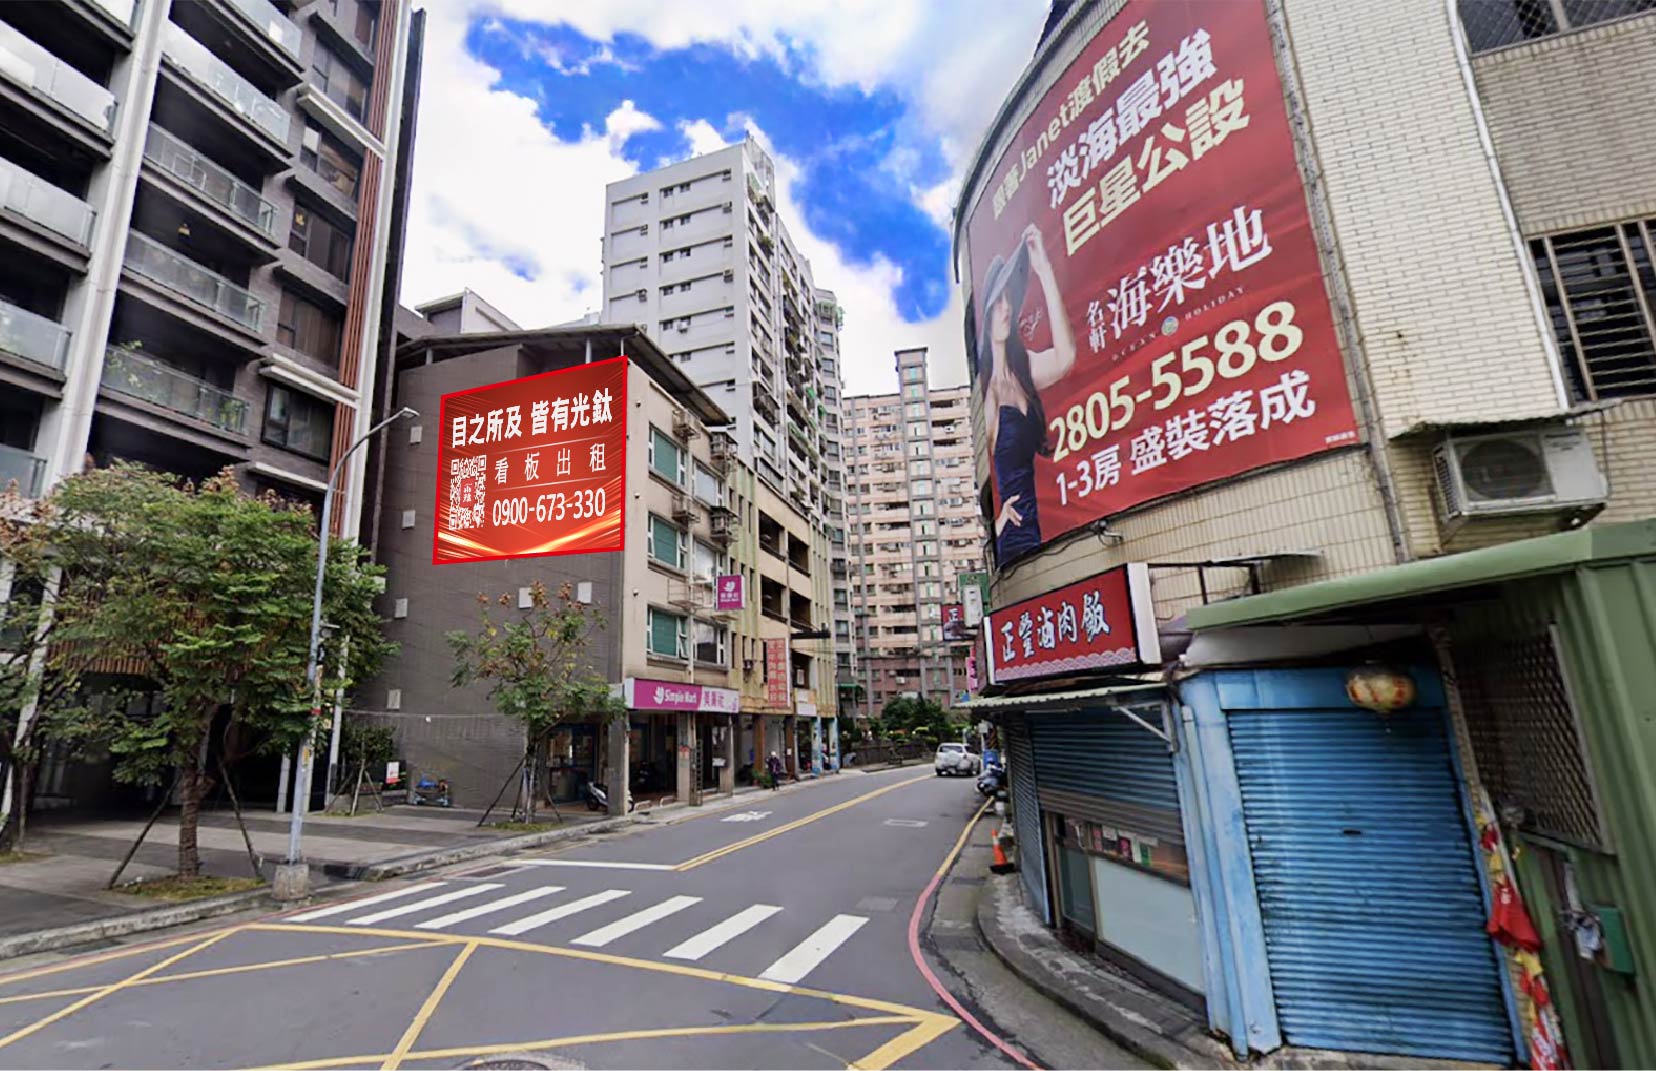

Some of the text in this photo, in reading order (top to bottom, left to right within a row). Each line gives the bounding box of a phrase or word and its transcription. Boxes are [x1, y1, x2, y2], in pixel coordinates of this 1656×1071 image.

[1045, 28, 1218, 209] 淡海最強
[1062, 79, 1250, 256] 巨星公設
[1107, 205, 1272, 340] 海樂地
[1184, 286, 1245, 321] HOLIDAY
[452, 388, 613, 449] 目之所及 皆有光鈦
[1048, 300, 1303, 463] 2805-5588
[1057, 369, 1316, 506] 1-3房 盛裝落成
[492, 487, 606, 527] 0900-673-330
[494, 443, 607, 486] 看板出租
